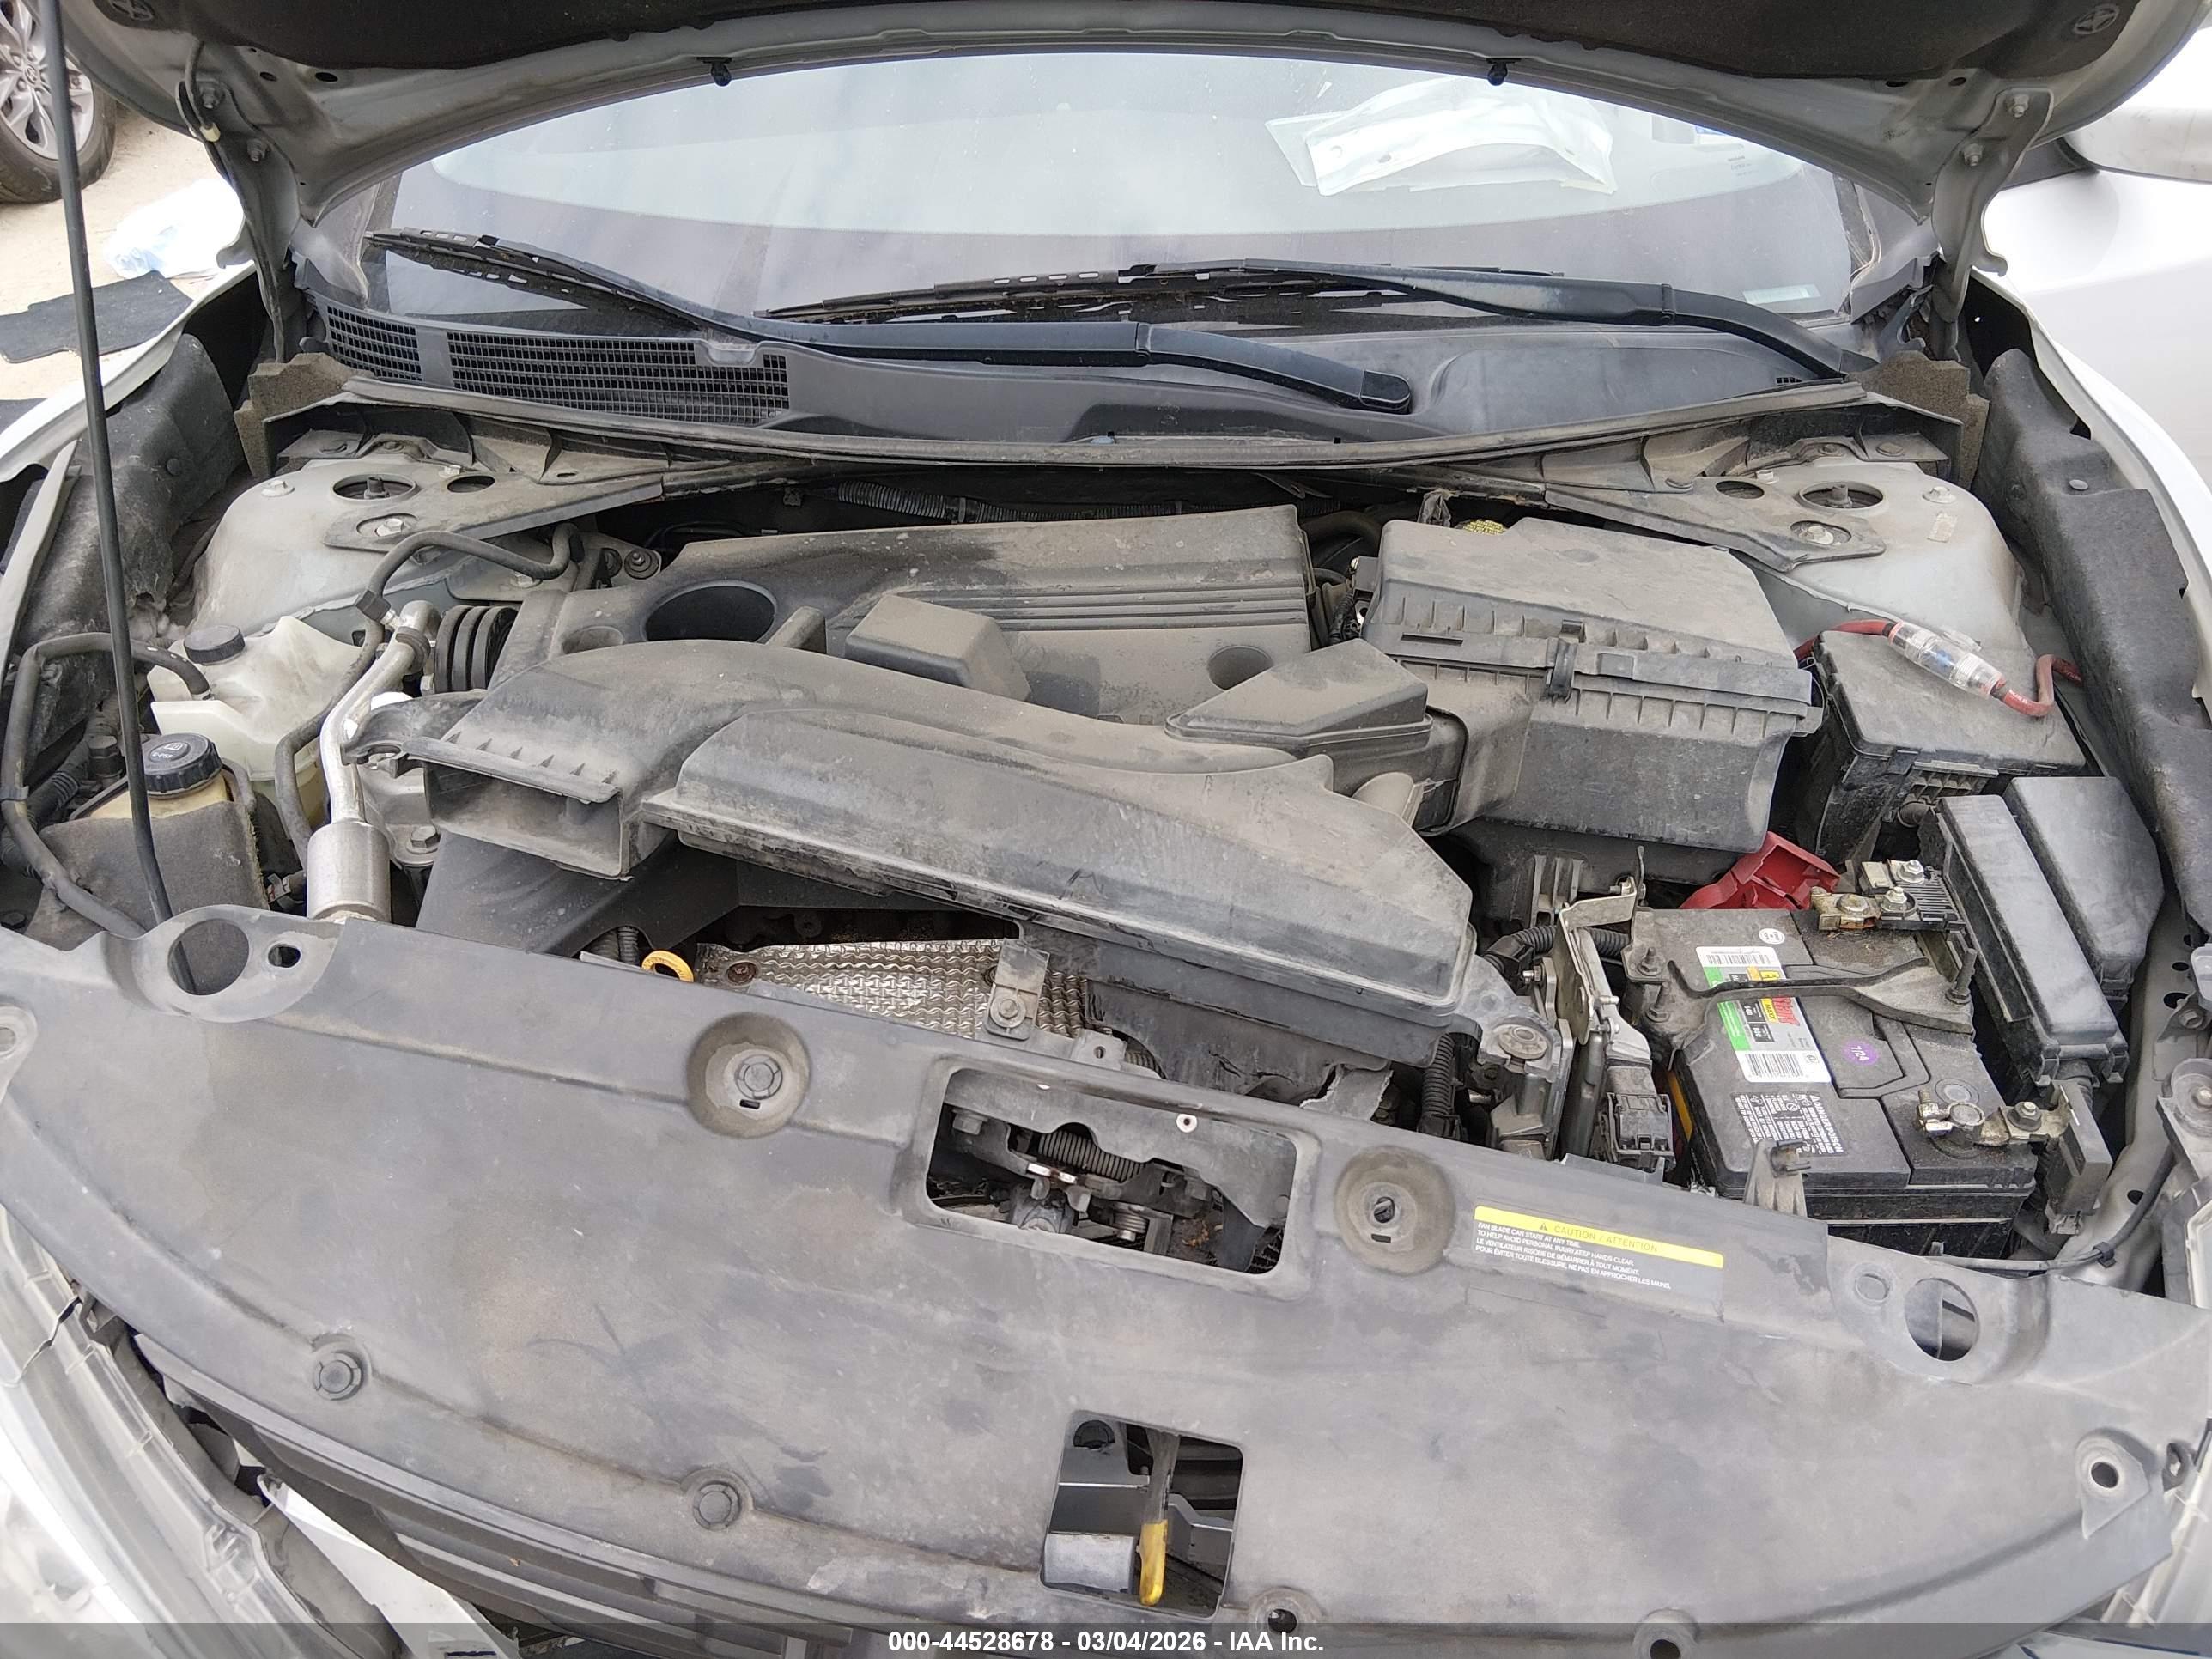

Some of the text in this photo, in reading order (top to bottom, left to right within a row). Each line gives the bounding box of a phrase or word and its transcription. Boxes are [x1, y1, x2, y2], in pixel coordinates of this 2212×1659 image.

[1486, 1231, 1503, 1240] HELP
[1503, 1234, 1522, 1243] AVOID
[1522, 1238, 1554, 1250] PERSONAL
[1591, 1252, 1613, 1261] HANDS
[1491, 1224, 1510, 1234] BLADE
[1525, 1231, 1545, 1241] START
[1553, 1225, 1596, 1241] CAUTION
[1607, 1236, 1658, 1253] ATTENTION
[1475, 1245, 1493, 1254] POUR
[1494, 1248, 1515, 1258] ÉVITER
[1515, 1253, 1534, 1262] TOUTE
[1600, 1269, 1638, 1283] APPROCHER
[1638, 1277, 1650, 1285] LES
[1485, 1239, 1522, 1253] VENTILATEUR
[1523, 1247, 1547, 1257] RISQUE
[1556, 1253, 1590, 1266] DÉMARRER
[1595, 1261, 1612, 1270] TOUT
